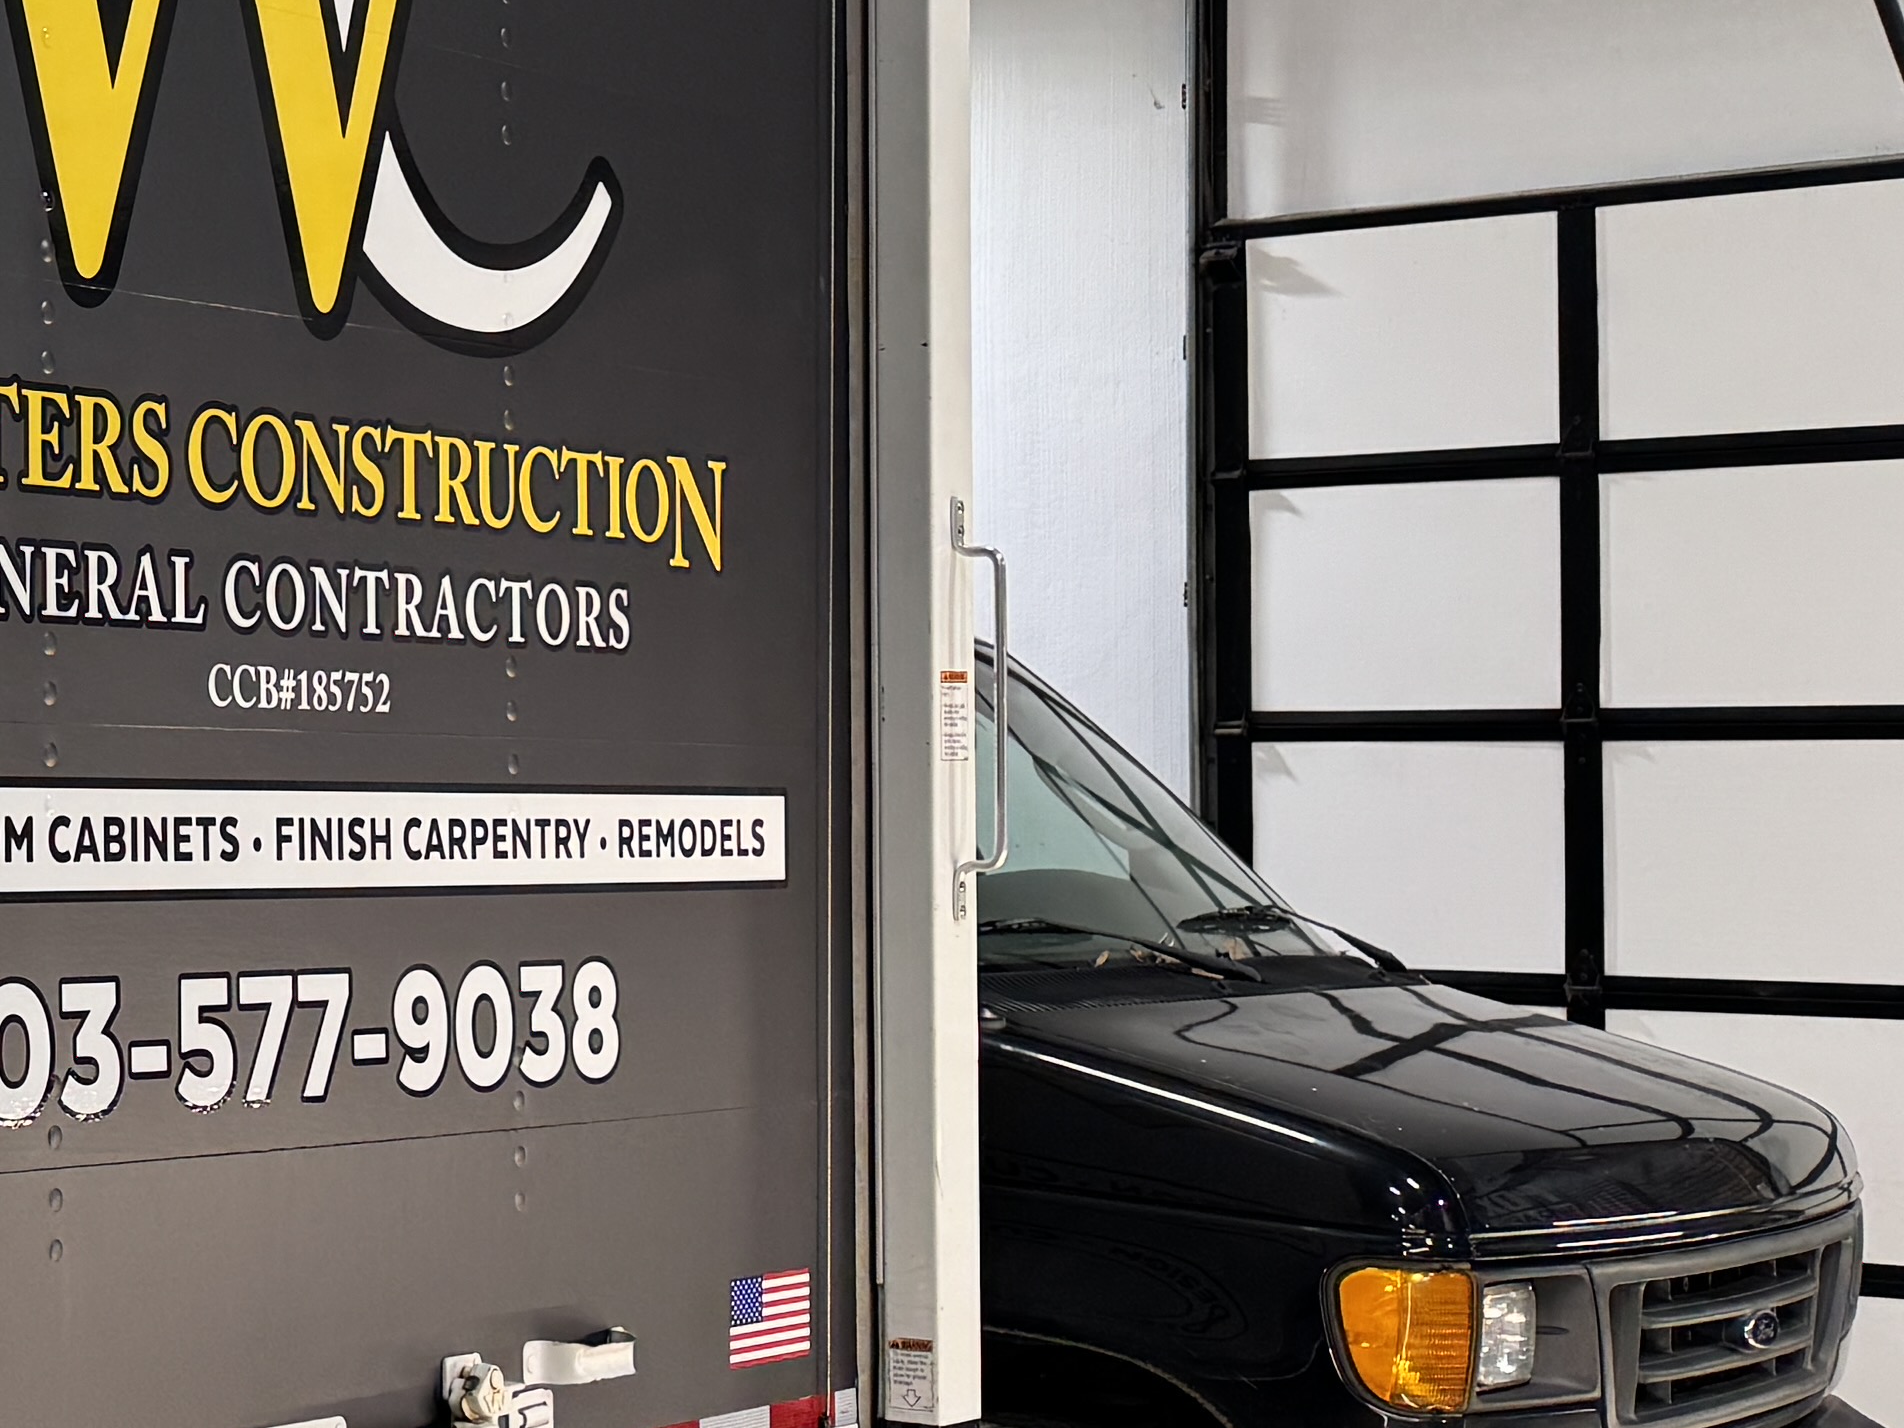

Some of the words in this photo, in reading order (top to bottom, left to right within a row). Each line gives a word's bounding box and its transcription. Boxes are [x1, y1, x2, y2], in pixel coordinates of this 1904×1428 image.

[188, 408, 730, 571] CONSTRUCTION
[223, 559, 631, 651] CONTRACTORS
[208, 663, 392, 714] CCB#185752
[47, 815, 241, 864] CABINETS
[274, 817, 393, 862] FINISH
[402, 817, 592, 861] CARPENTRY
[617, 818, 766, 859] REMODELS
